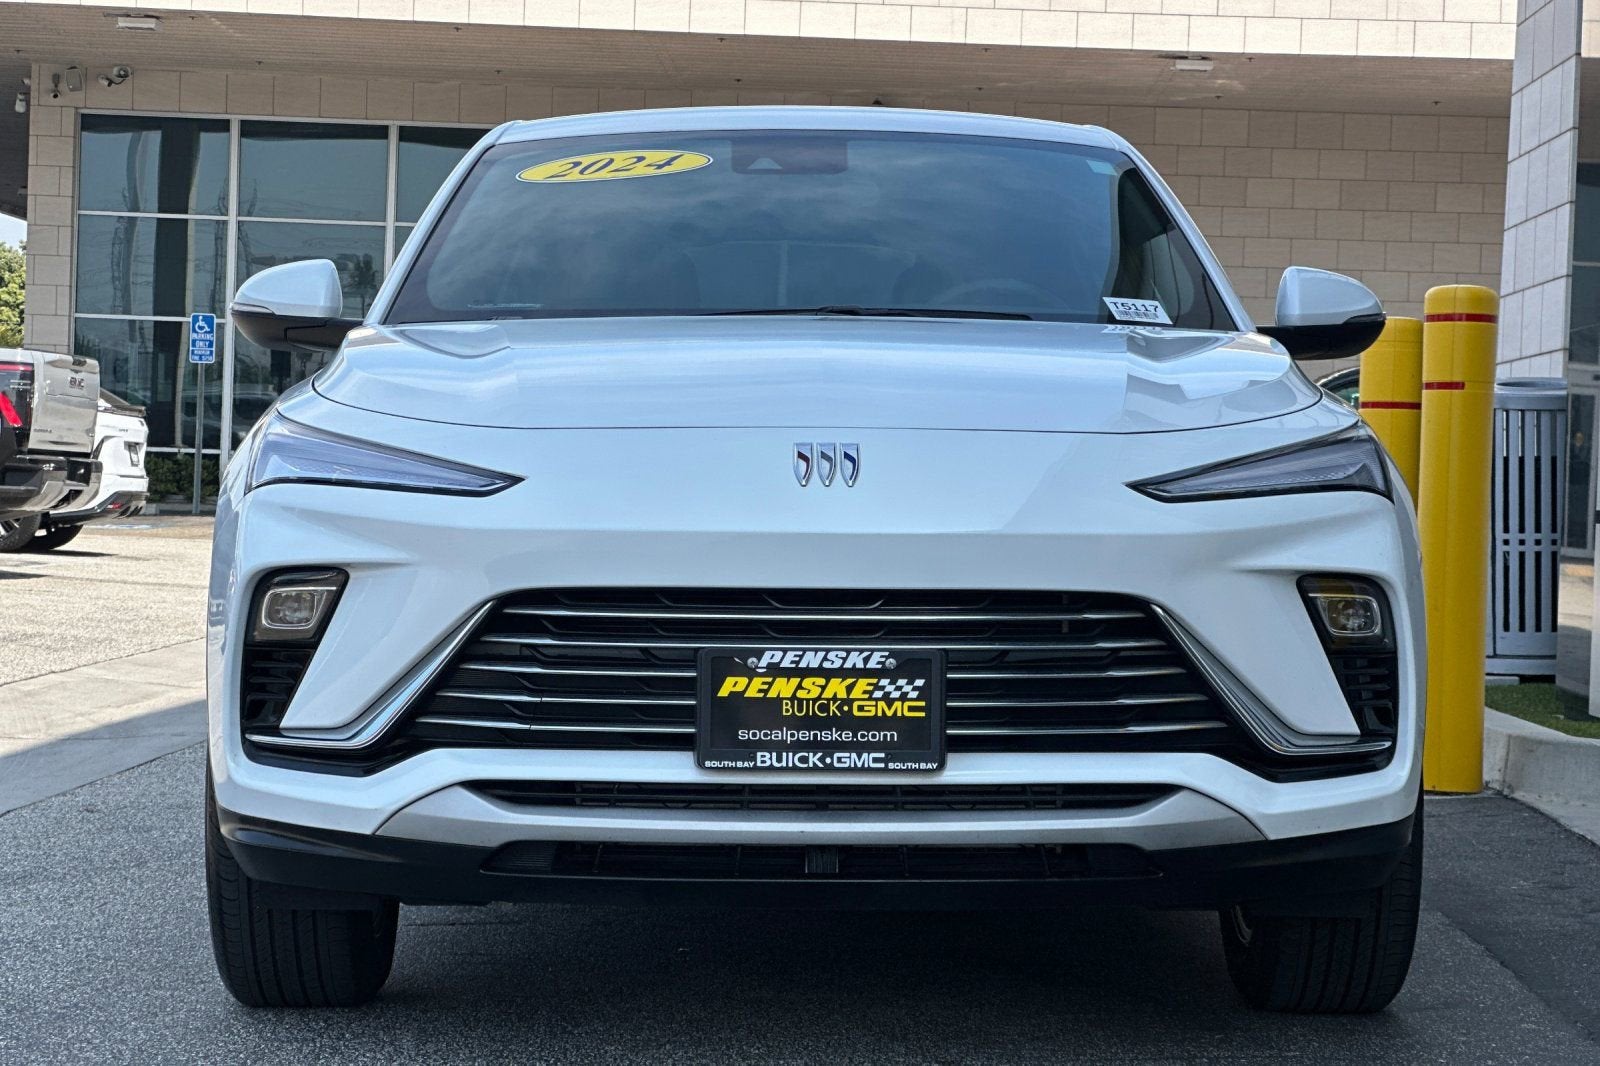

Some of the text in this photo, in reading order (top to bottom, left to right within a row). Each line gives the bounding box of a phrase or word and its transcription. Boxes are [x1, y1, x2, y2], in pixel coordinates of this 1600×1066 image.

[544, 153, 684, 179] 2024
[1109, 301, 1159, 312] T5117
[757, 650, 889, 668] PENSKE
[716, 676, 878, 699] PENSKE
[738, 727, 898, 744] socalpenske.com
[704, 760, 737, 768] SOUTH
[888, 762, 920, 770] SOUTH
[920, 762, 938, 770] BAY
